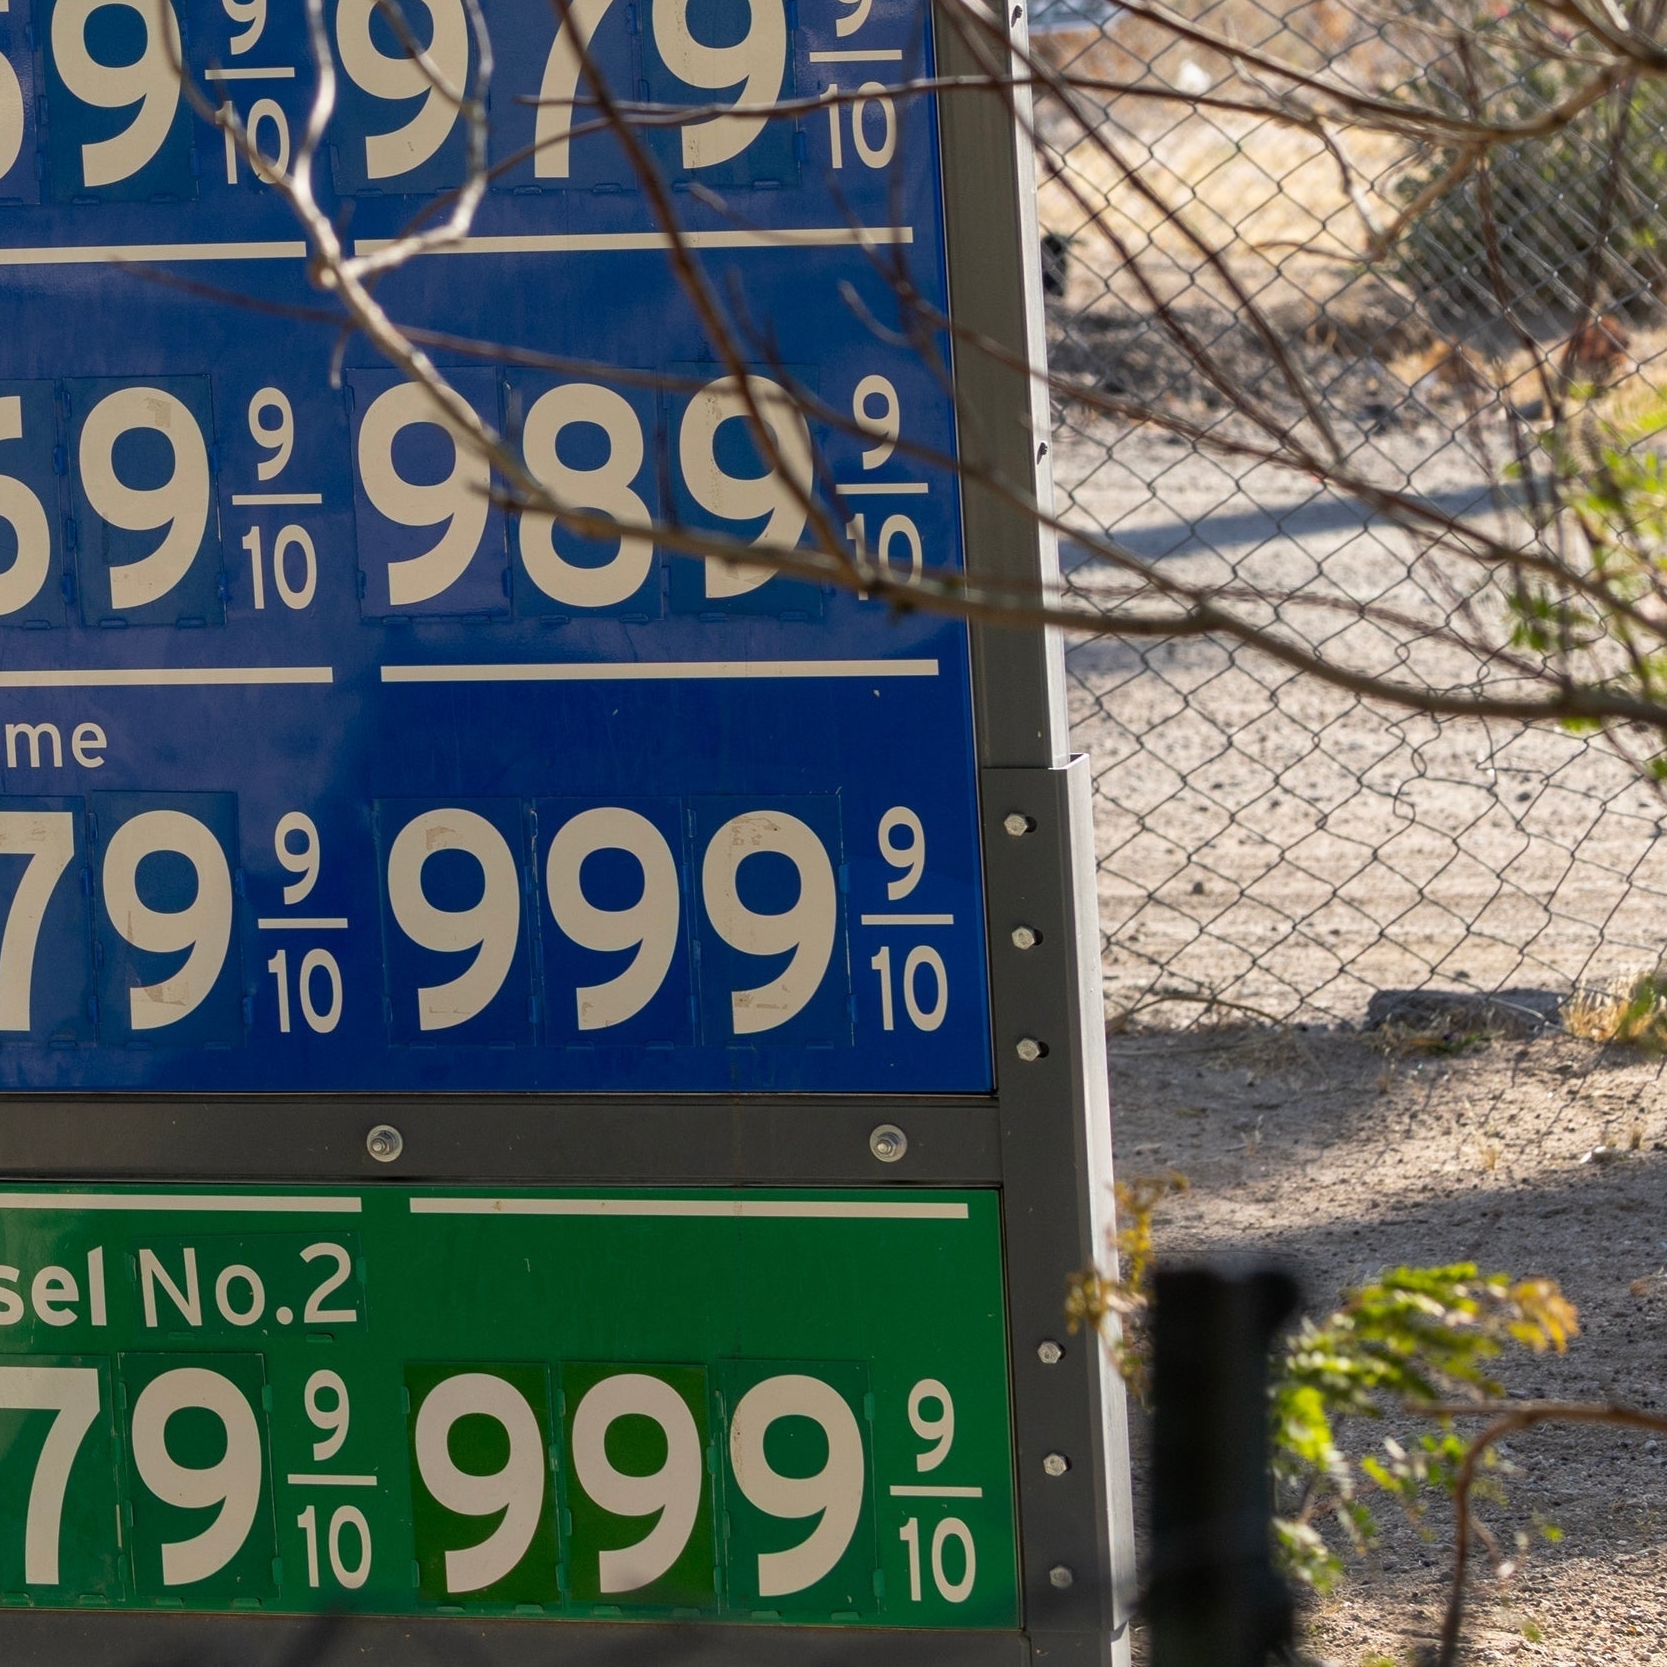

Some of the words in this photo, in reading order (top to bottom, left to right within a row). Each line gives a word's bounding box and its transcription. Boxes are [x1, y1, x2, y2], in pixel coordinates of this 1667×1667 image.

[358, 378, 813, 606] 989
[389, 808, 836, 1033] 999
[139, 1243, 356, 1327] No.2
[416, 1373, 864, 1596] 999
